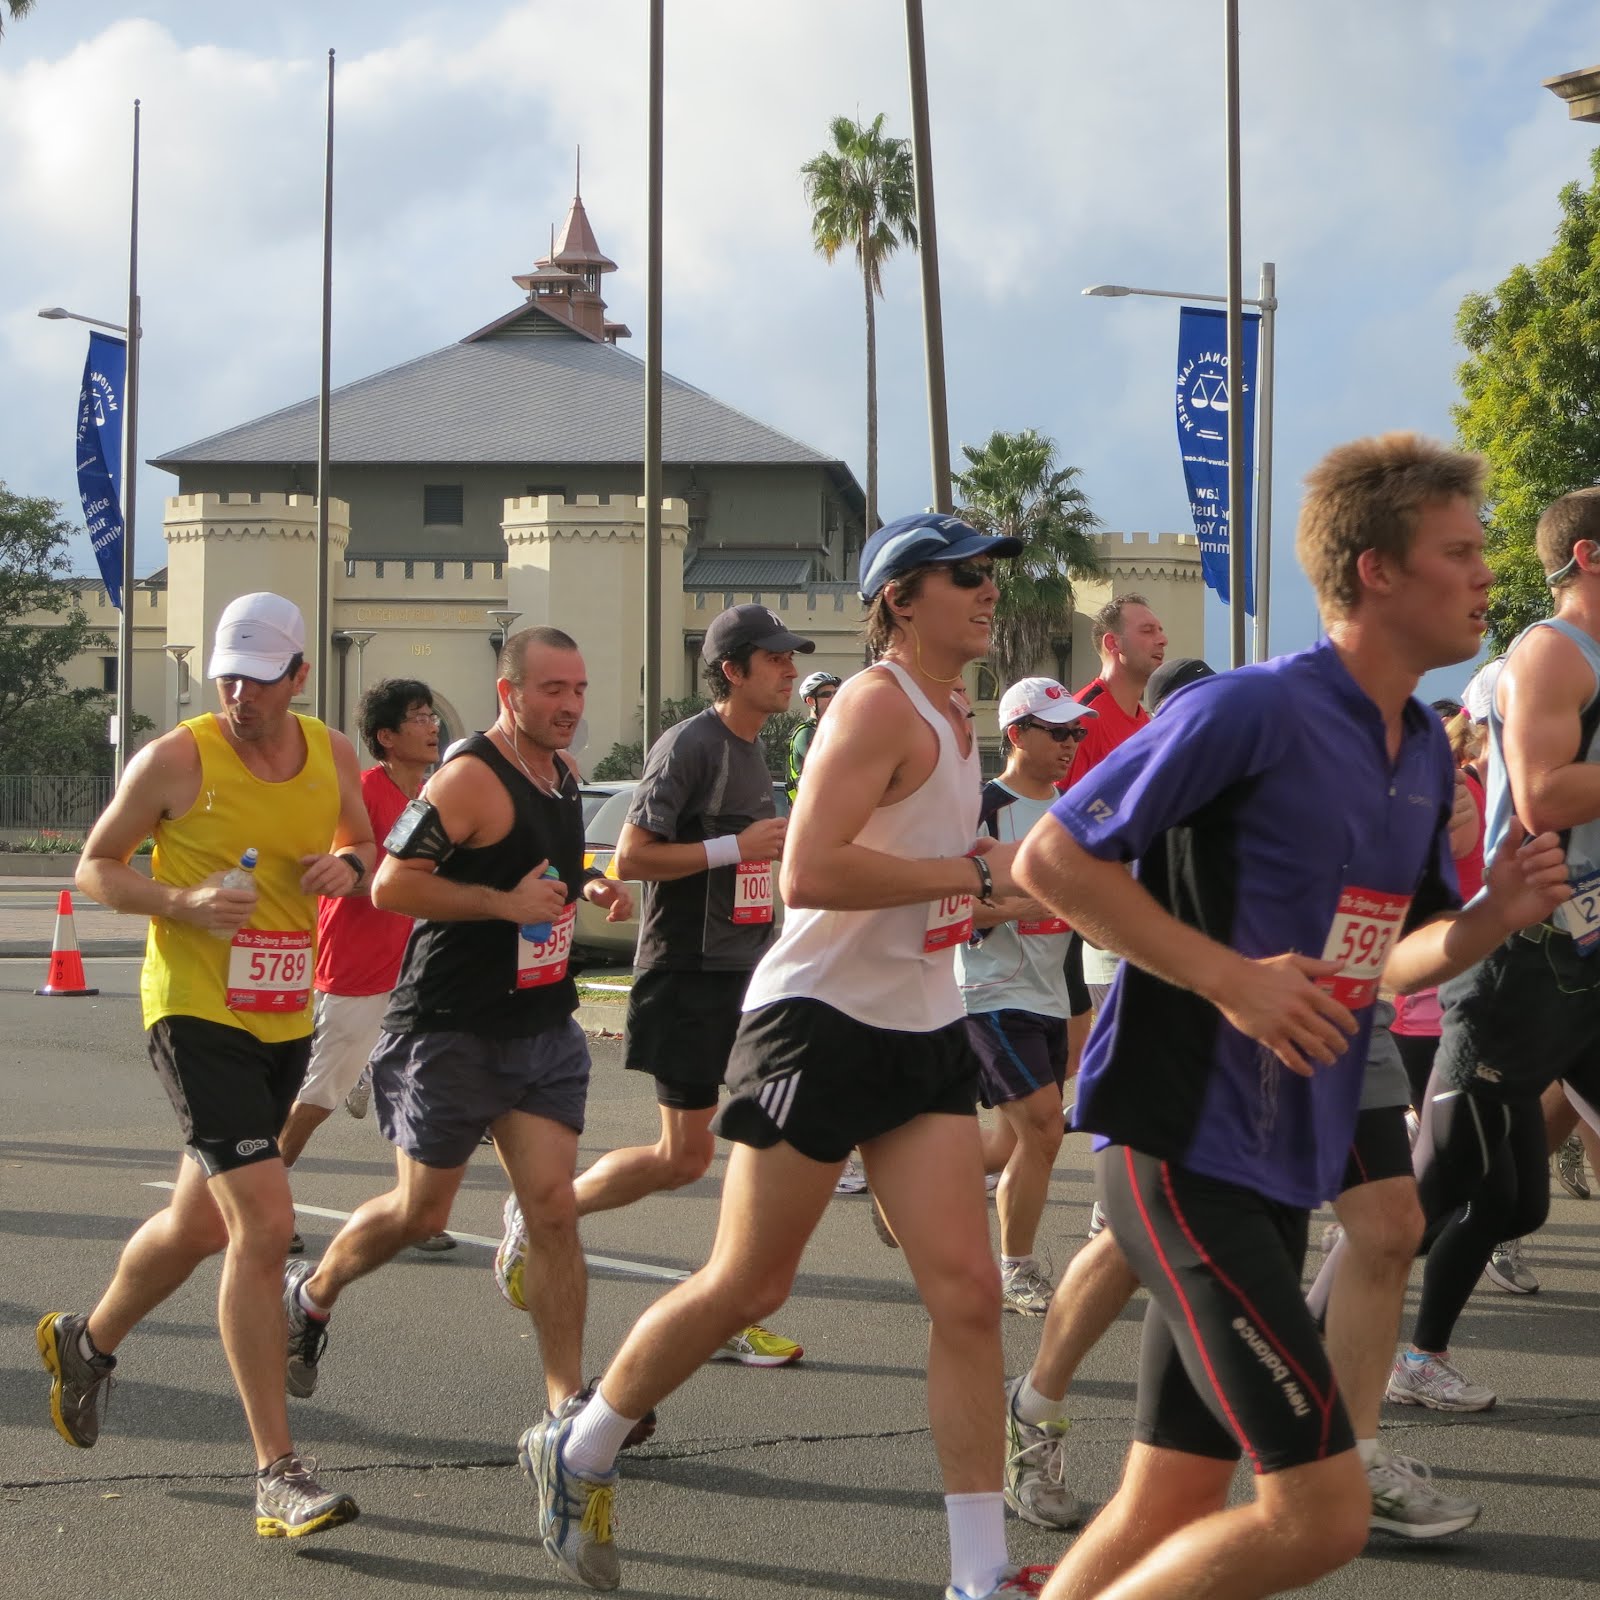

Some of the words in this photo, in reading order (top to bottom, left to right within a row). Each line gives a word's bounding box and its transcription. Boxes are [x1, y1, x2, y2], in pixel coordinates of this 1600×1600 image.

[411, 644, 432, 656] 1915
[249, 952, 306, 982] 5789
[1231, 1317, 1290, 1382] balance
[1281, 1381, 1311, 1417] new
